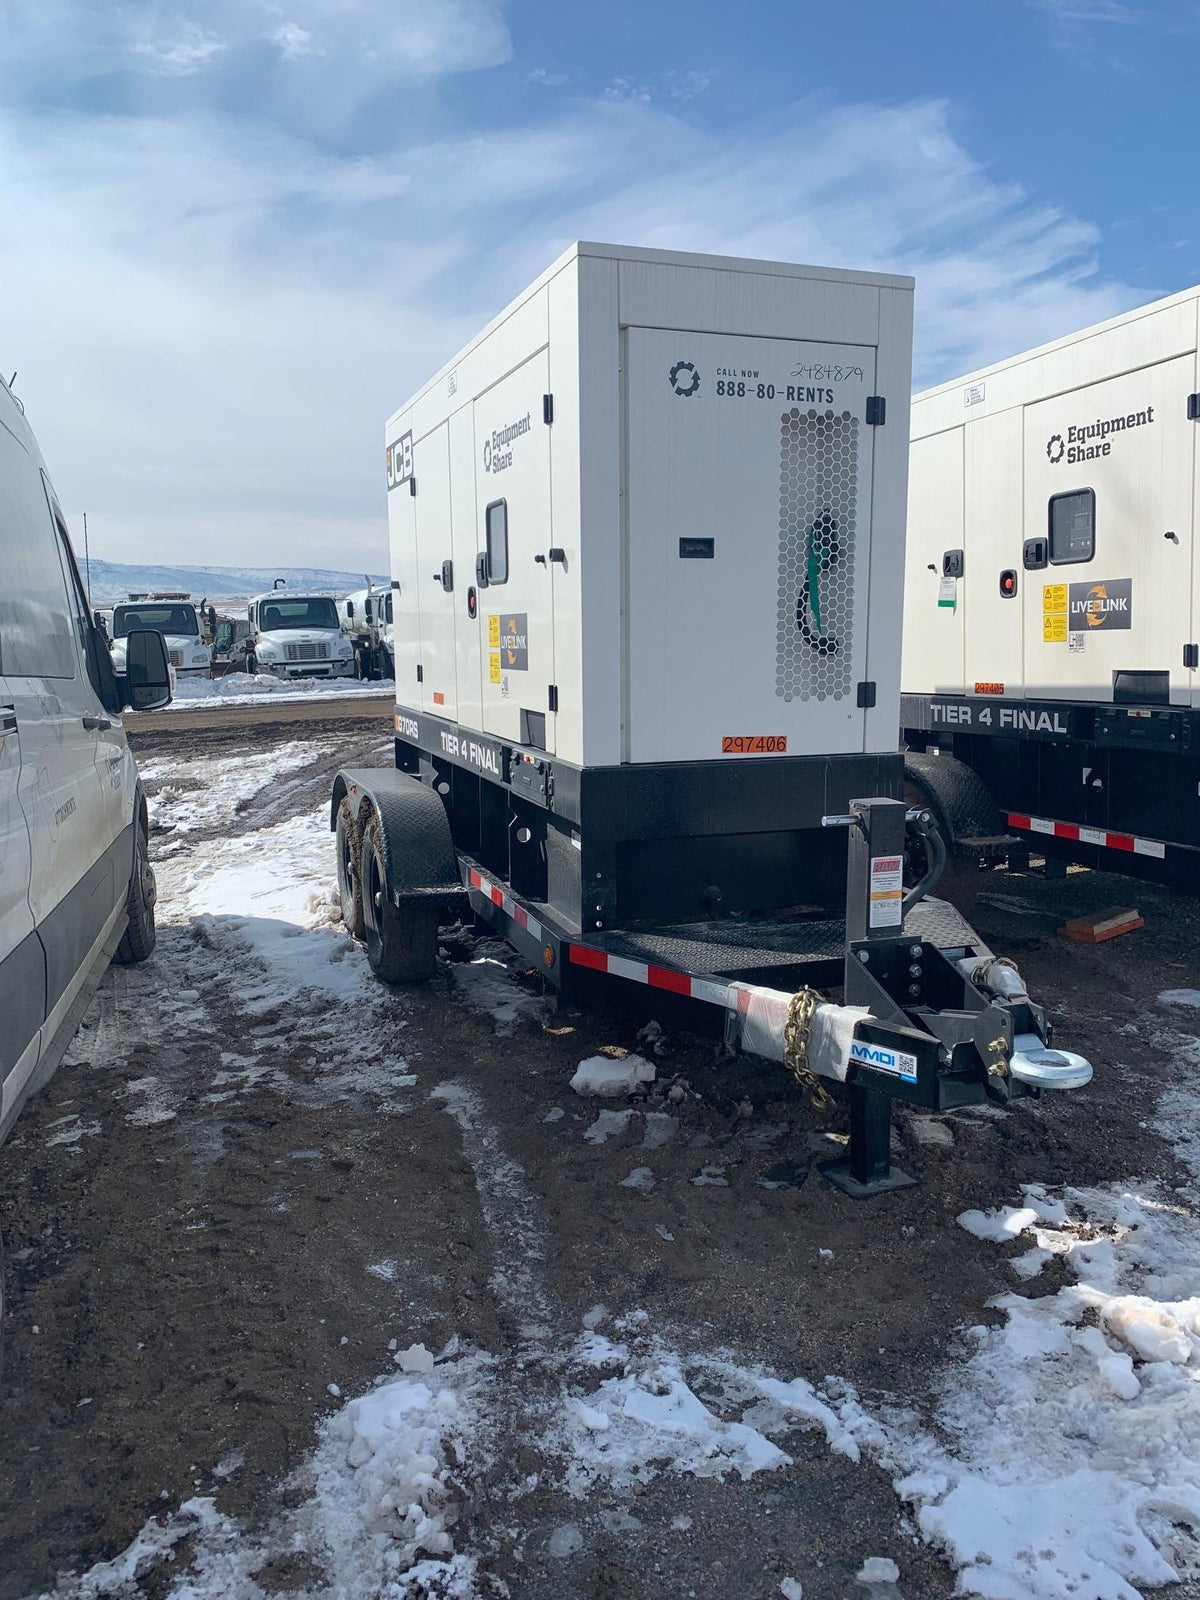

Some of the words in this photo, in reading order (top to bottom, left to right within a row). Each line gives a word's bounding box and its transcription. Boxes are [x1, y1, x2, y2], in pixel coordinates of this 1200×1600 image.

[716, 368, 737, 377] CALL
[741, 370, 760, 379] NOW
[790, 362, 864, 383] 2484879
[716, 380, 834, 403] 888-80-RENTS
[492, 412, 531, 452] Equipment
[1067, 406, 1154, 444] Equipment
[387, 435, 413, 487] JCB
[492, 451, 513, 474] Share
[1067, 442, 1111, 464] Share
[930, 705, 972, 724] TIER
[978, 707, 992, 726] 4
[1000, 708, 1067, 733] FINAL
[440, 731, 459, 757] TIER
[461, 739, 468, 760] 4
[469, 742, 500, 775] FINAL
[723, 736, 786, 752] 297406
